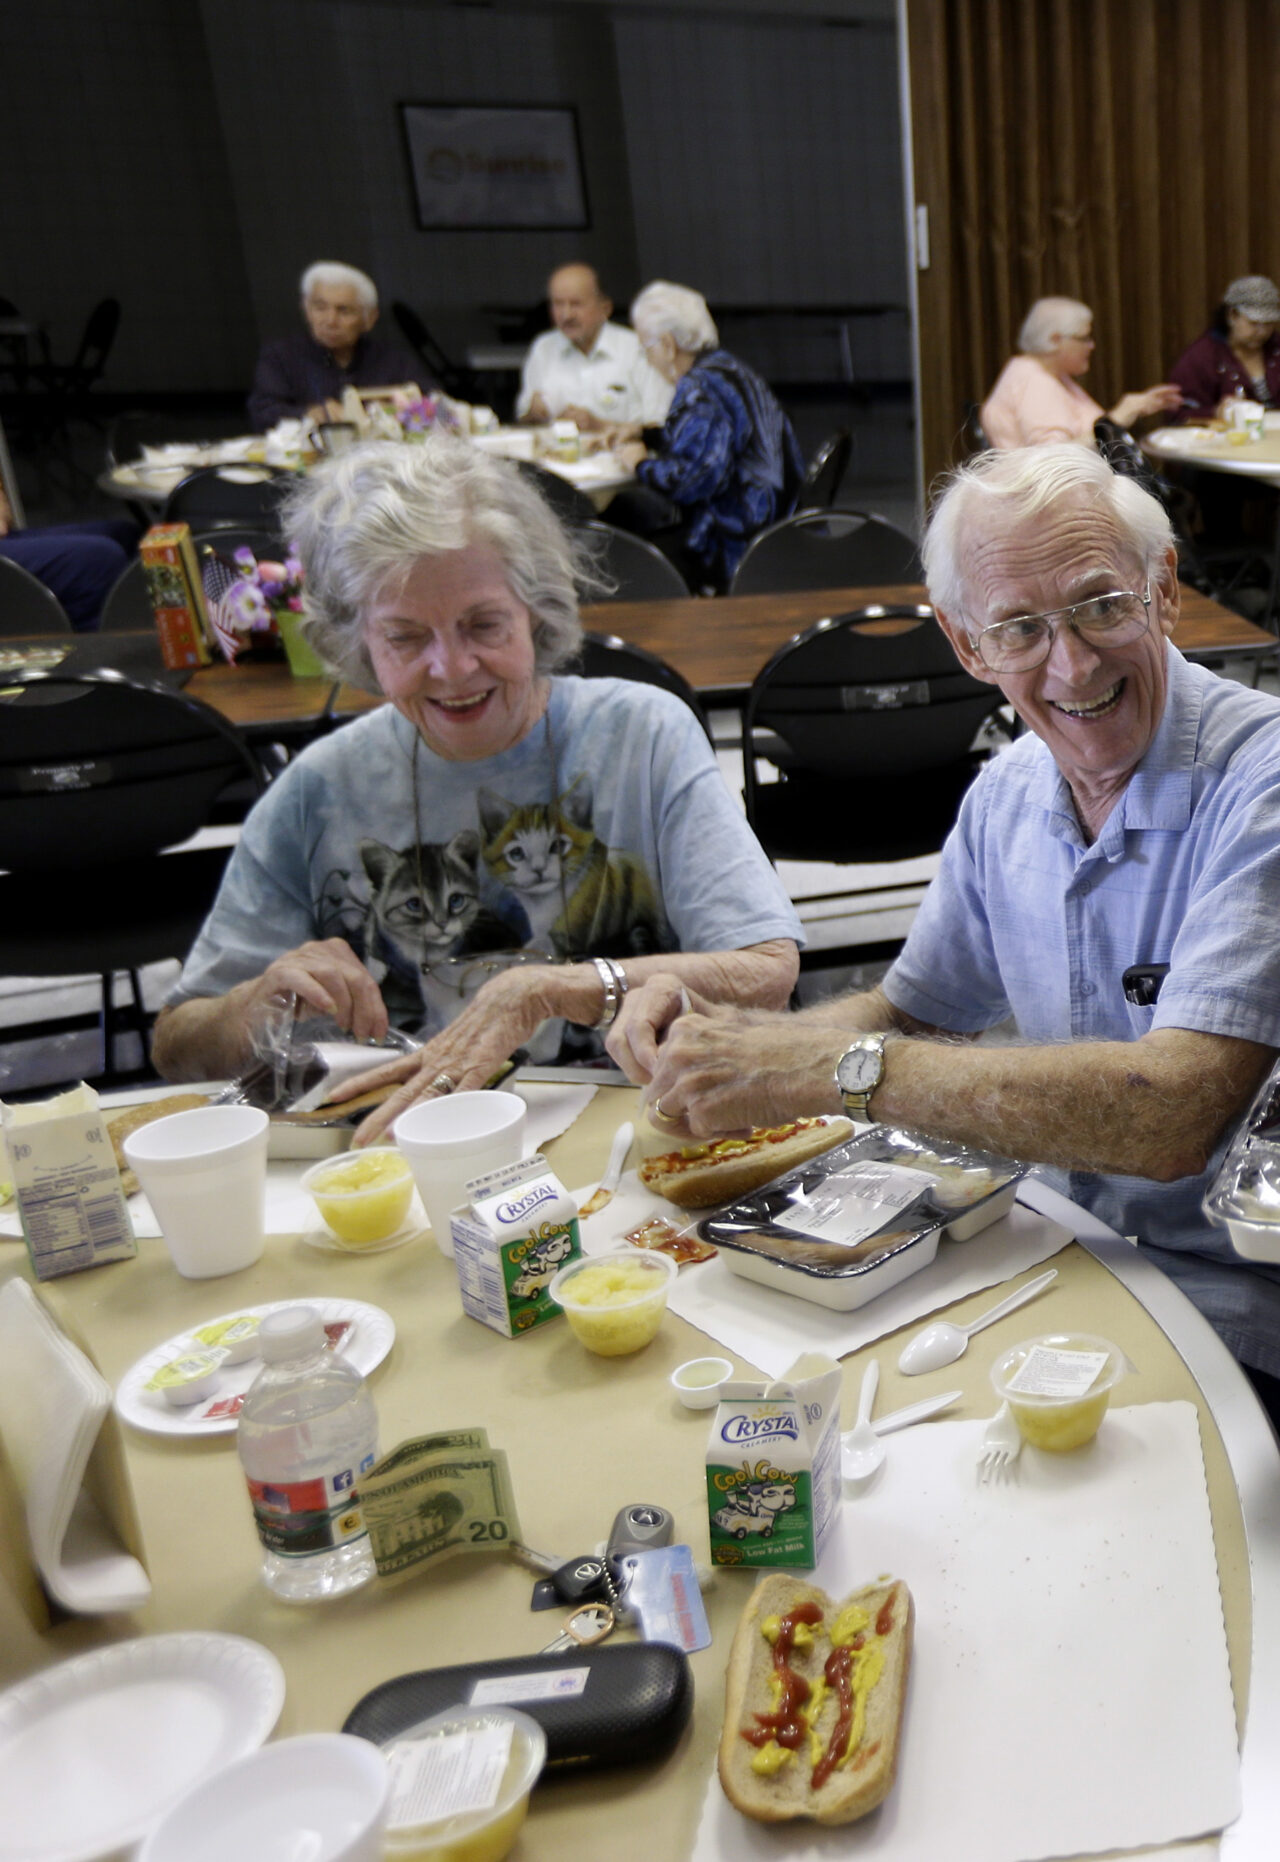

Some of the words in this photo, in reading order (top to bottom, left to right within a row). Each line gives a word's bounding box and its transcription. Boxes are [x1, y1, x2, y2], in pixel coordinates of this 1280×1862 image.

[495, 1184, 559, 1224] CRYSTAL
[508, 1228, 539, 1264] Cool
[721, 1415, 799, 1443] CRYSTAL
[713, 1460, 753, 1491] Cool
[754, 1459, 799, 1483] Cow
[469, 1520, 508, 1543] 20
